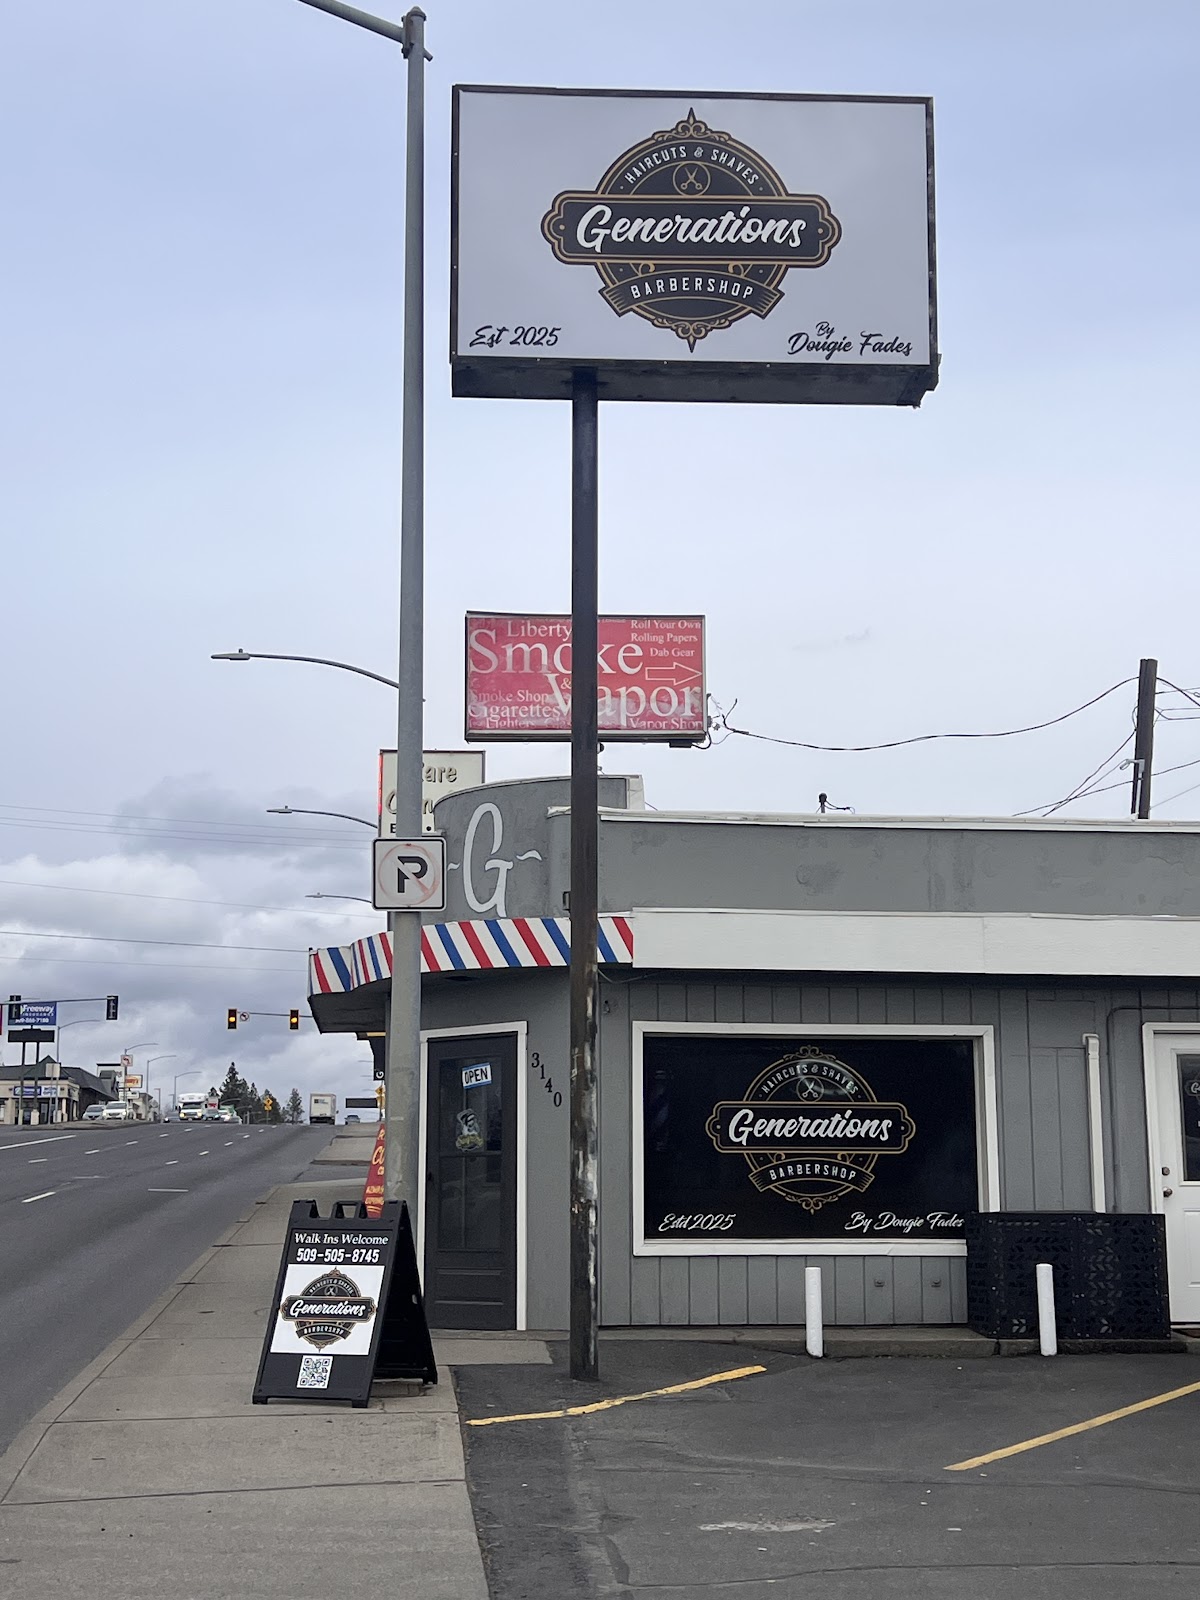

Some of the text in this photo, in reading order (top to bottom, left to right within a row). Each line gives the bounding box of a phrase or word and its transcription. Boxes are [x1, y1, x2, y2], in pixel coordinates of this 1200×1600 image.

[624, 146, 760, 186] HAIRCUTS & SHAVES
[576, 204, 807, 253] Generations
[631, 277, 755, 300] BARBERSHOP
[469, 325, 562, 348] Est 2025
[816, 321, 835, 340] By
[788, 331, 913, 362] Dougie Fades
[507, 620, 572, 641] Liberty
[631, 619, 651, 629] Roll
[653, 619, 676, 629] Your
[678, 619, 702, 629] Own
[631, 633, 698, 644] Rolling Papers
[650, 647, 695, 657] Dab Gear
[517, 689, 549, 705] Shop
[422, 762, 457, 783] are
[464, 1066, 488, 1085] OPEN
[761, 1064, 808, 1095] HAIRCUTS
[822, 1066, 859, 1095] SHAVES
[728, 1109, 892, 1146] Generations
[769, 1163, 857, 1181] BARBERSHOP
[845, 1212, 965, 1234] By Dougie Fades
[295, 1233, 389, 1245] Walk Ins Welcome
[296, 1248, 380, 1263] 509-505-8745
[289, 1299, 366, 1318] Generations
